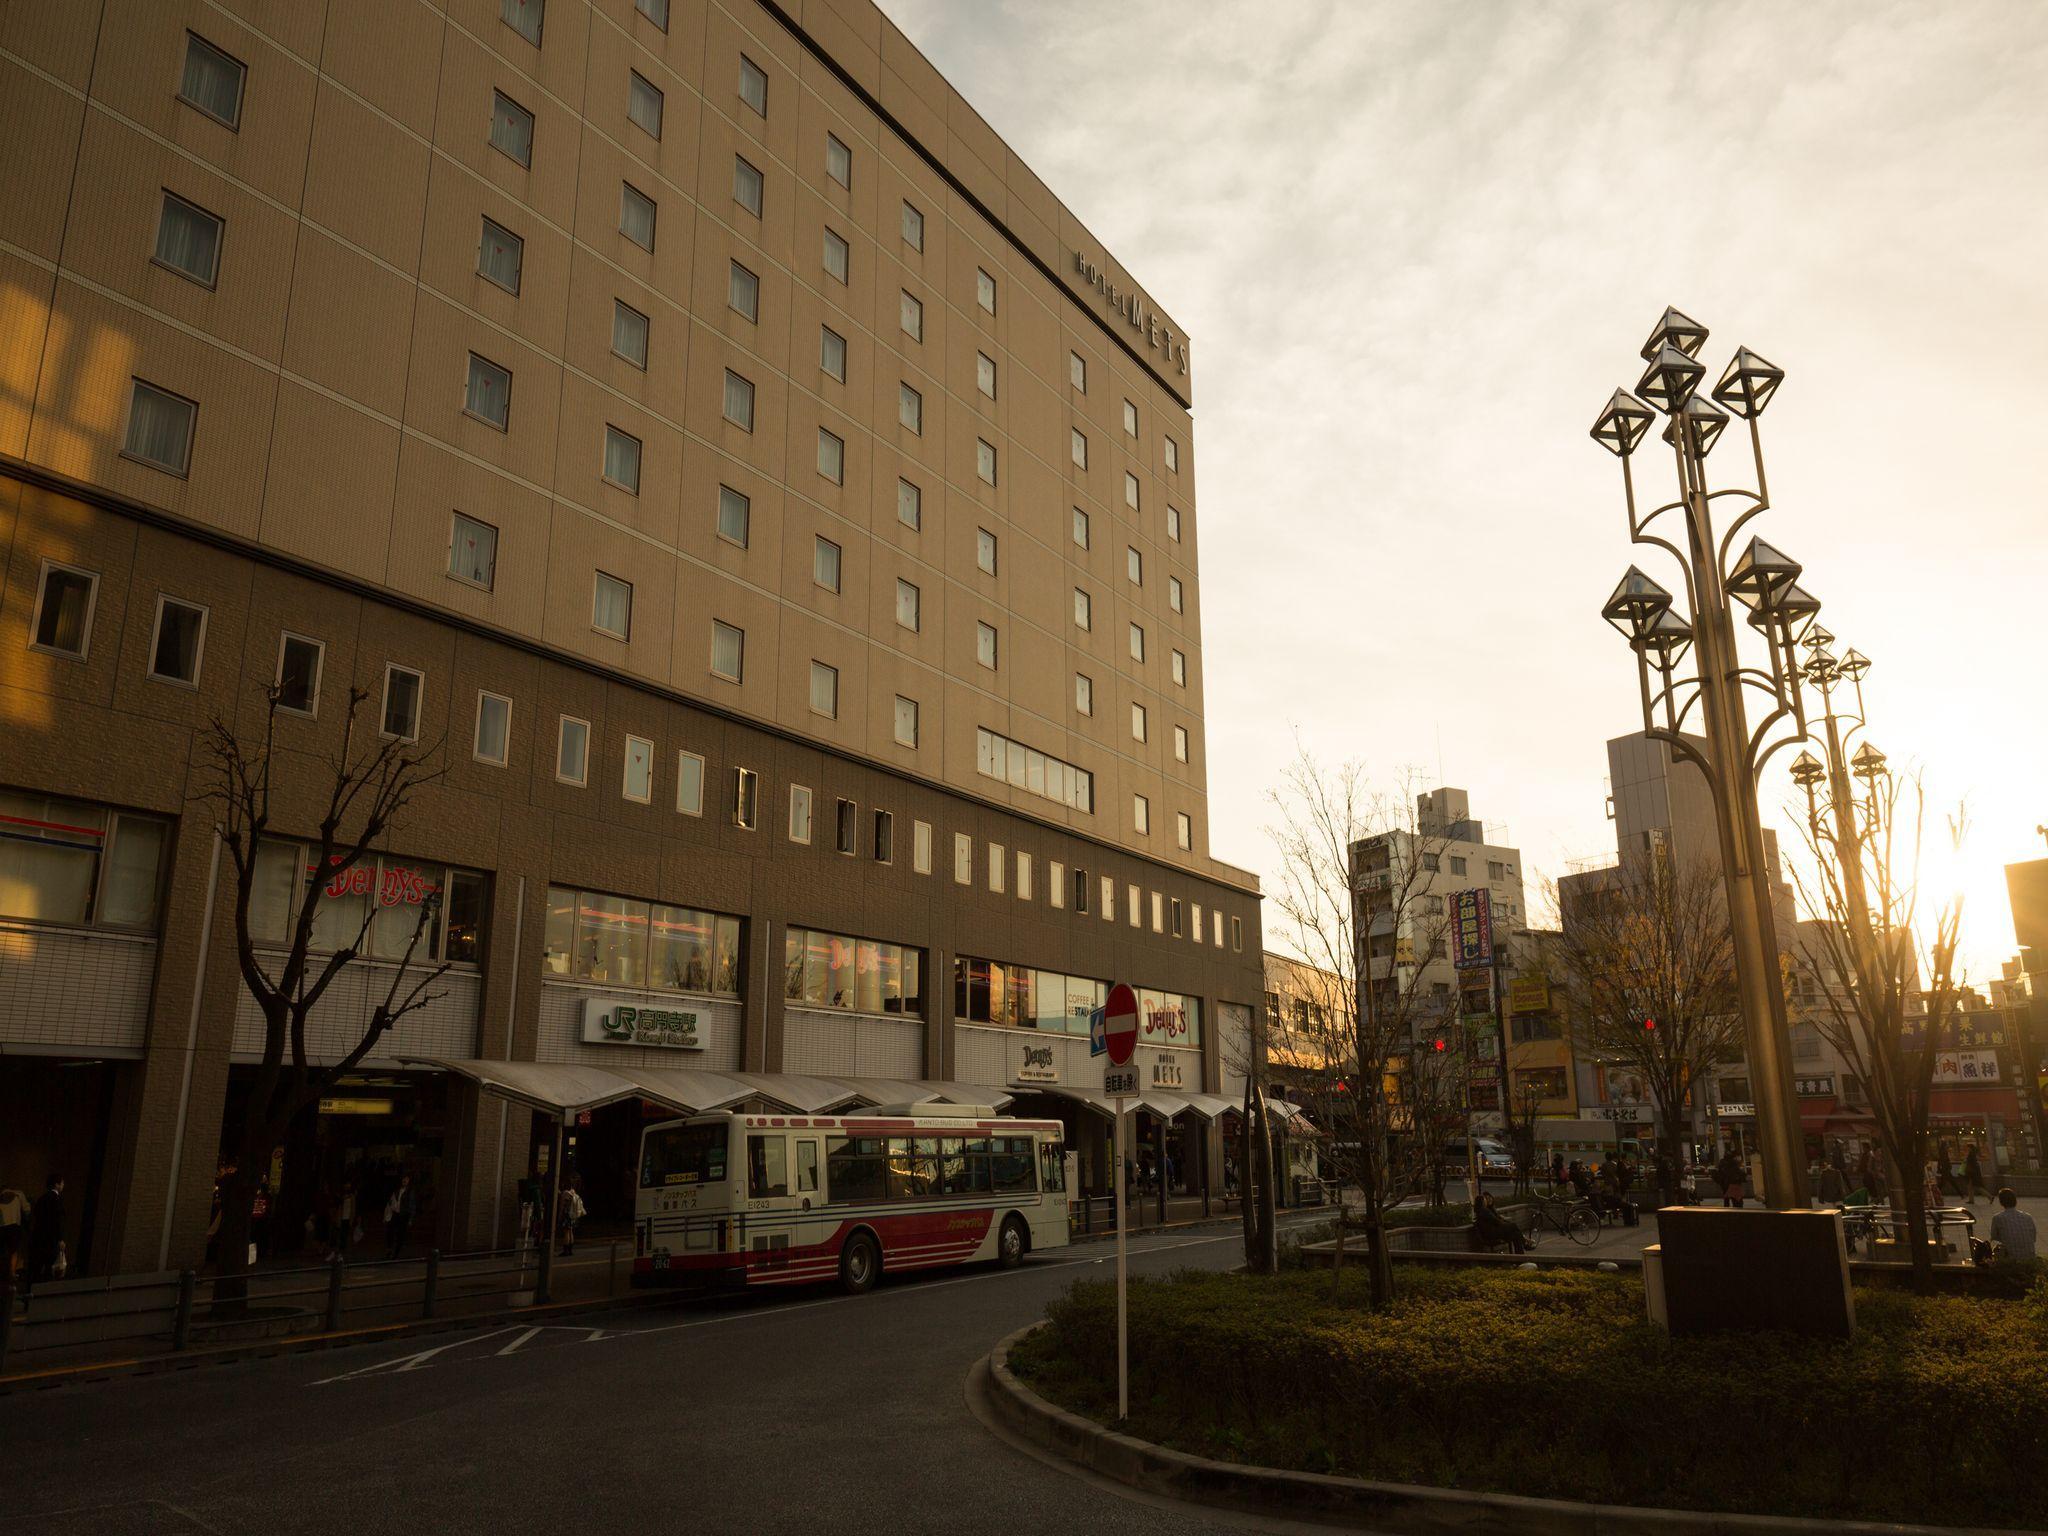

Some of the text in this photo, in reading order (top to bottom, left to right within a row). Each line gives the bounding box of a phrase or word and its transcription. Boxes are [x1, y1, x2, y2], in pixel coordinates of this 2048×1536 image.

[1076, 250, 1188, 376] HOTEL METS
[1068, 993, 1089, 1006] COFFEE
[602, 1006, 637, 1032] JR
[639, 1009, 697, 1033] 高円寺駅
[1144, 999, 1186, 1038] Denny's
[1023, 1045, 1053, 1069] Denny's
[1105, 1073, 1137, 1093] 自転車を除く
[1153, 1065, 1182, 1084] METS
